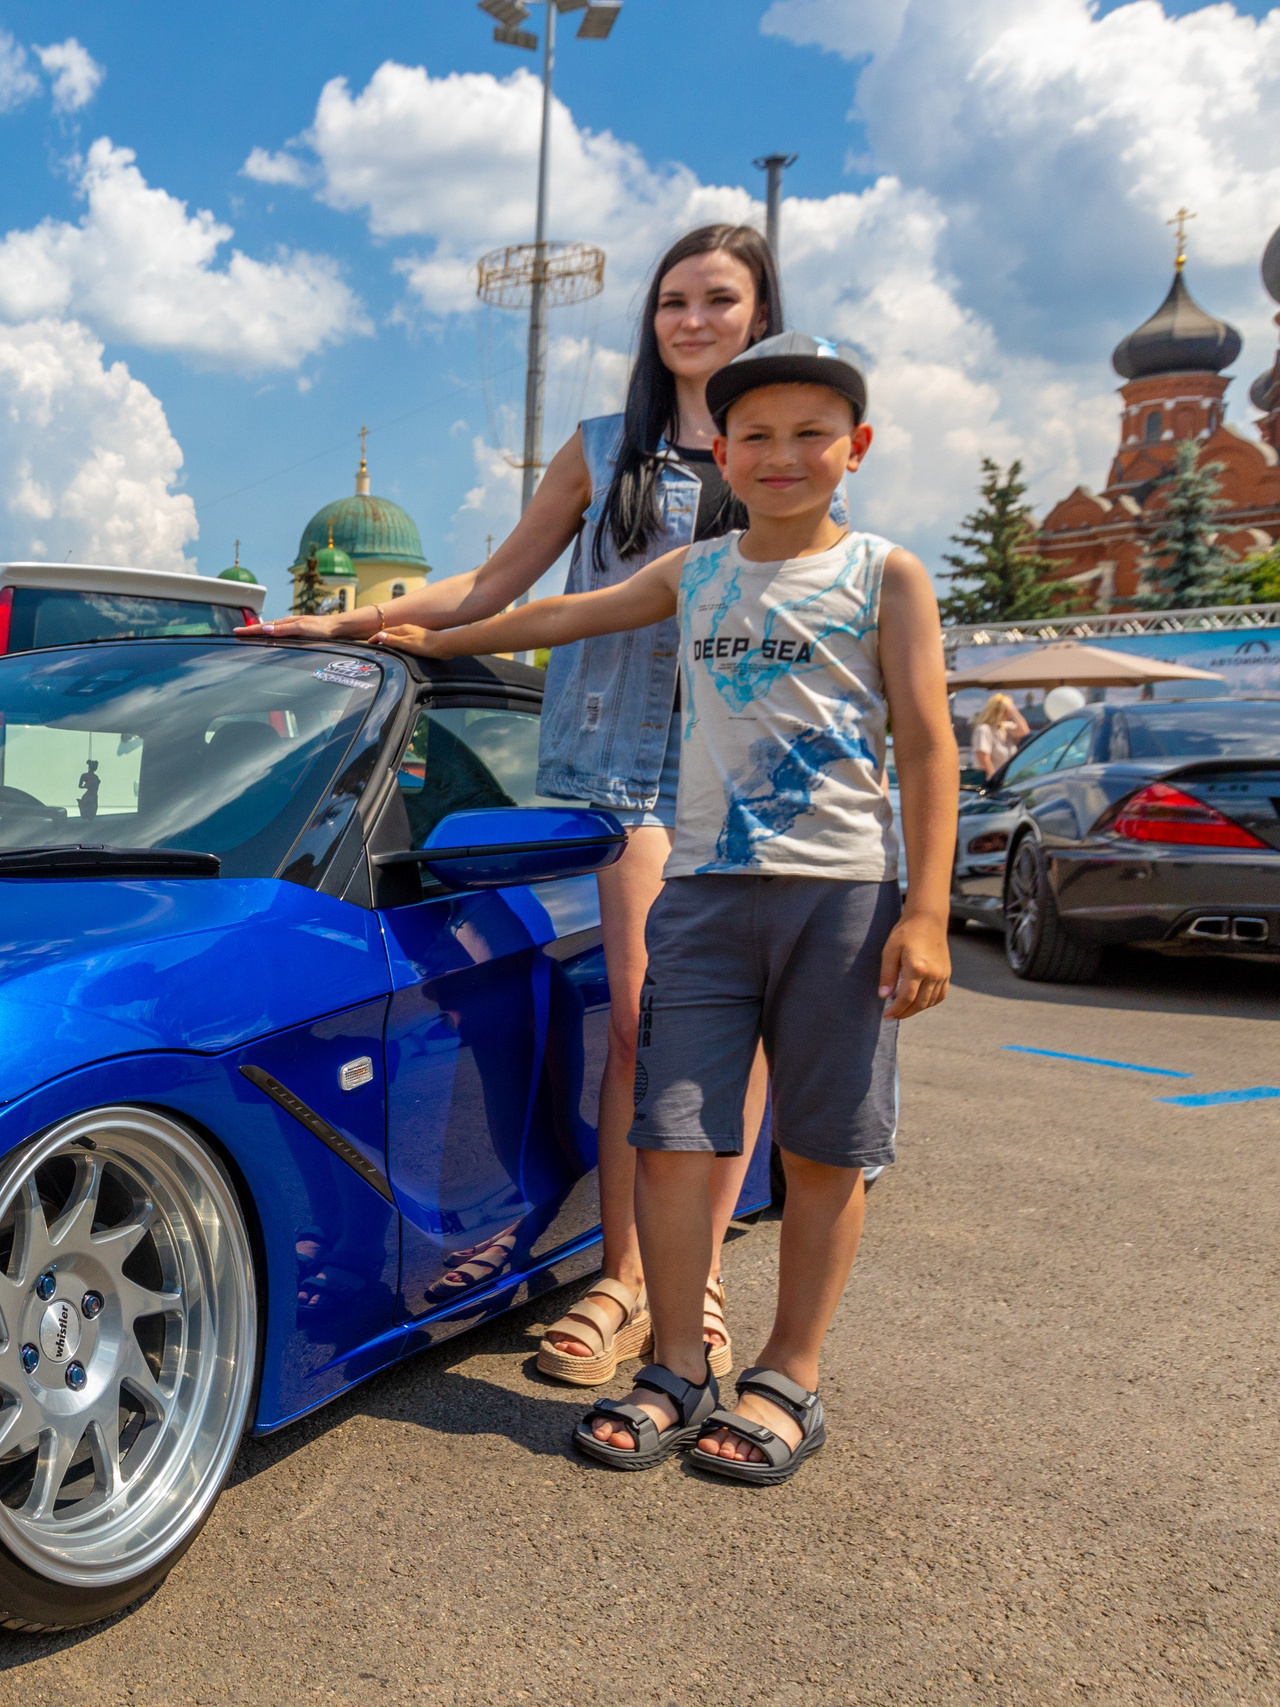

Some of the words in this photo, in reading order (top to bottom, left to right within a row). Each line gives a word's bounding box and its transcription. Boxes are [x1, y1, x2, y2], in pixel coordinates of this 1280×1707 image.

[694, 637, 750, 661] DEEP
[761, 639, 811, 663] SEA
[56, 1305, 69, 1357] whistler
